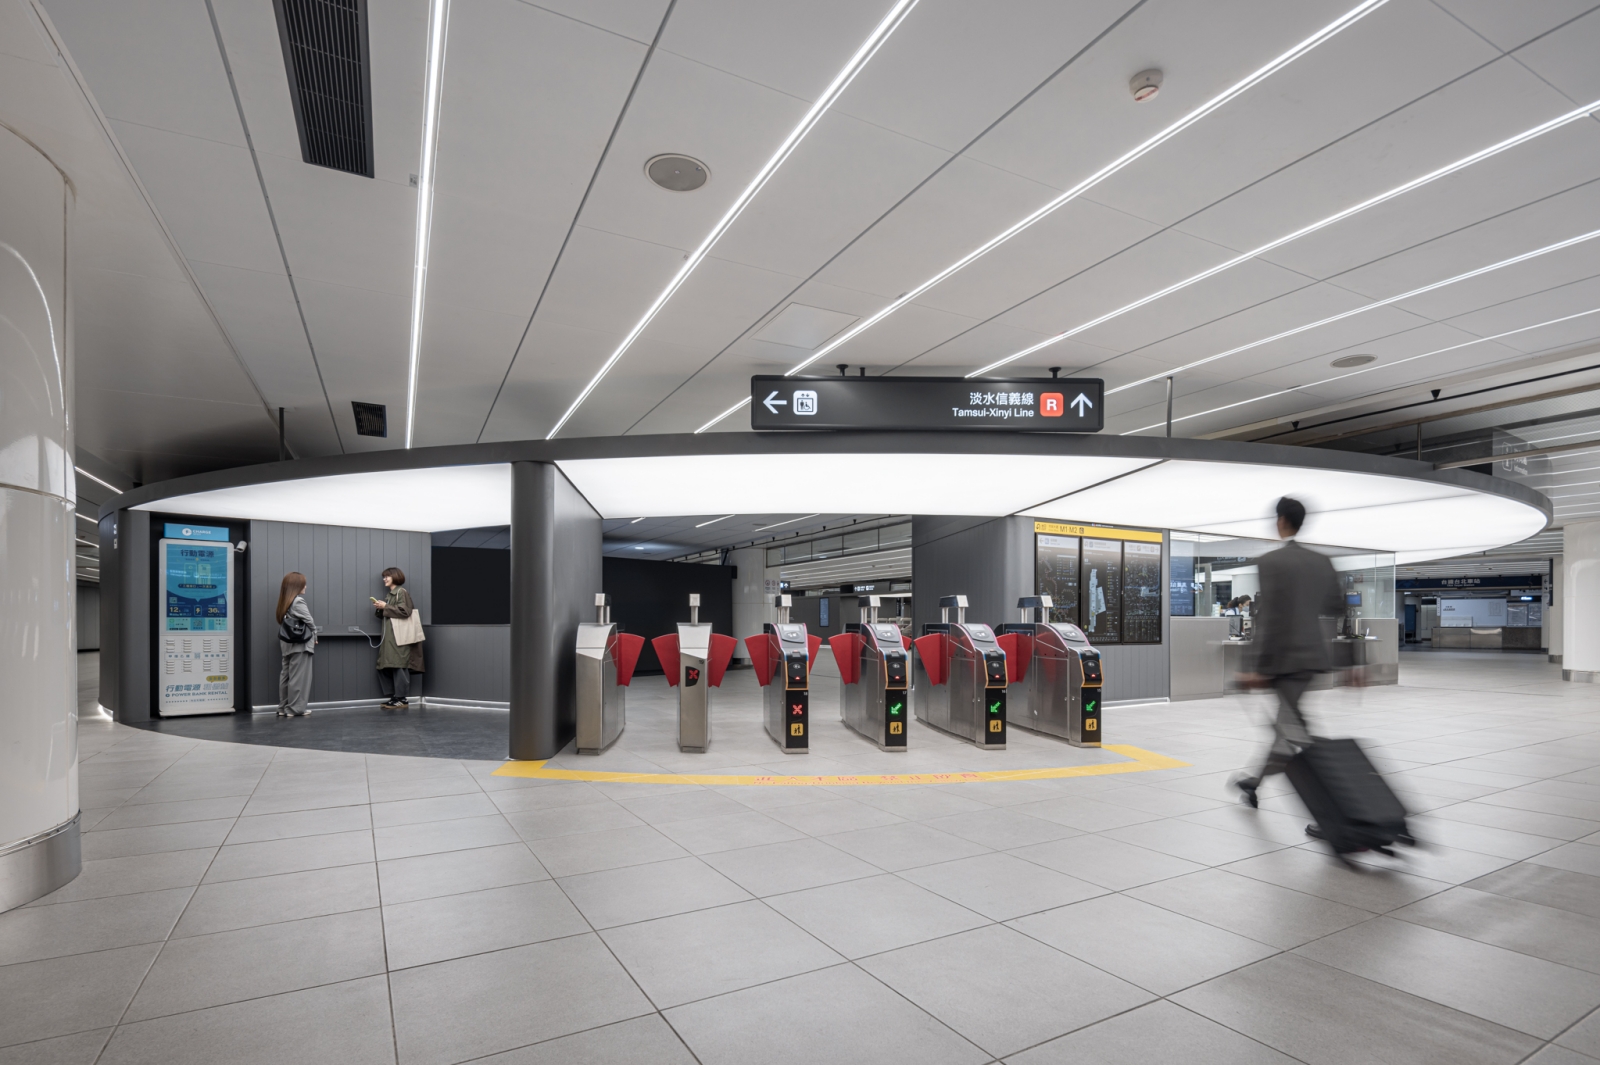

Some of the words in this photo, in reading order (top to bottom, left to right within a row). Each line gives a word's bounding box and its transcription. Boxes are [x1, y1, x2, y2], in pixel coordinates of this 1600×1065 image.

[969, 392, 1034, 406] 淡水信義線
[1046, 399, 1058, 411] R
[952, 407, 1012, 420] Tamsui-Xinyi
[1014, 408, 1034, 417] Line
[180, 549, 214, 558] 行動電源
[165, 683, 201, 692] 行動電源
